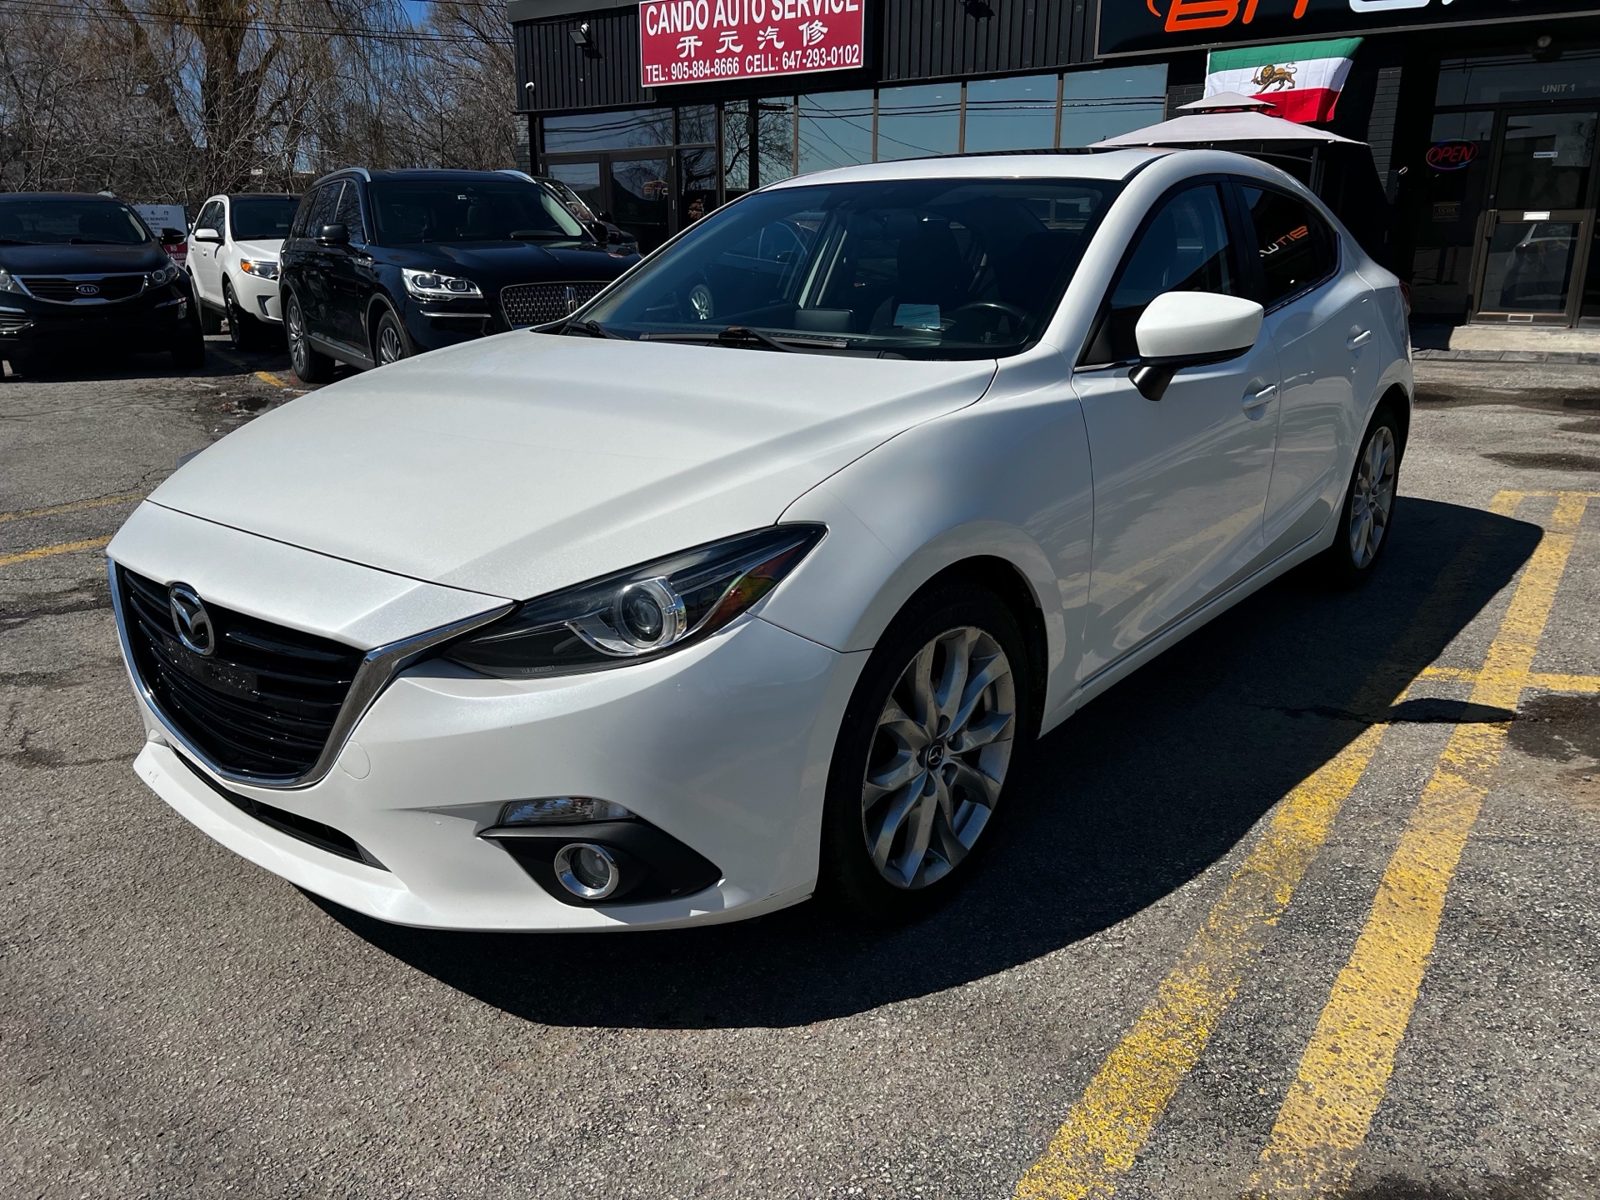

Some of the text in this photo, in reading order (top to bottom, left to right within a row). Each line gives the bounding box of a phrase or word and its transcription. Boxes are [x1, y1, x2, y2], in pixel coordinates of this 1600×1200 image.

[646, 0, 709, 36] CANDO
[713, 0, 765, 28] AUTO
[676, 20, 828, 58] 开元汽修
[646, 44, 859, 82] TEL: 905-884-8666 CELL: 647-293-0102
[1542, 83, 1576, 94] UNIT 1
[1428, 145, 1474, 162] OPEN
